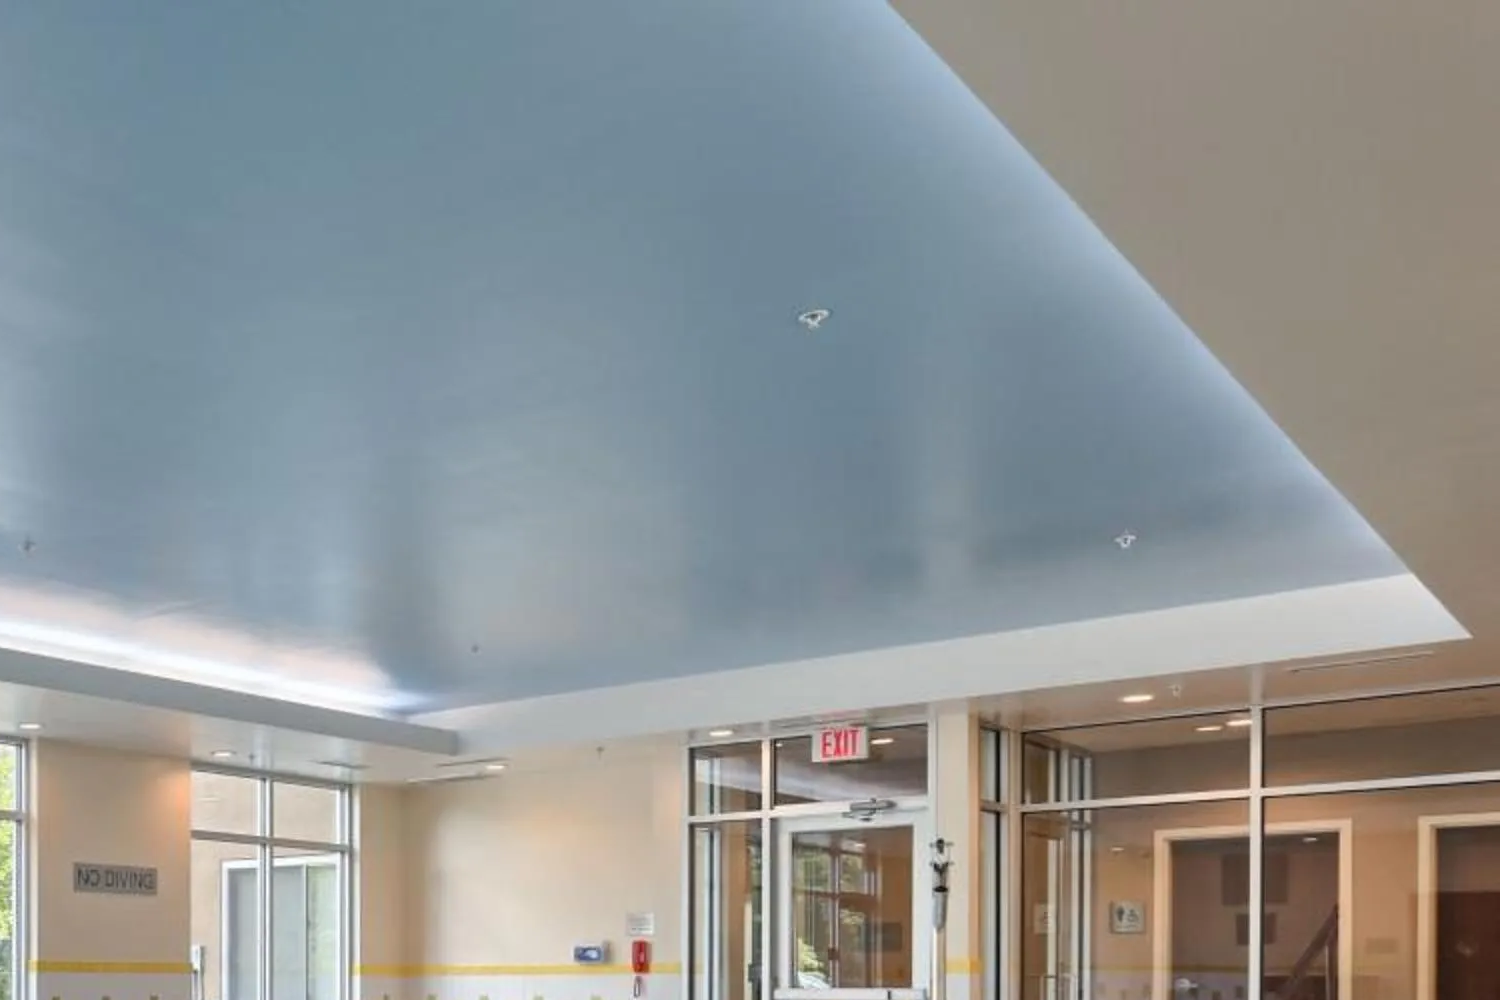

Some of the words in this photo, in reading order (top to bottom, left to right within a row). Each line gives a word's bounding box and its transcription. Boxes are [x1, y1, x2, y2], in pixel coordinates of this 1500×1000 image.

[822, 729, 859, 758] EXIT
[77, 868, 100, 887] NO
[104, 869, 157, 891] DIVING
